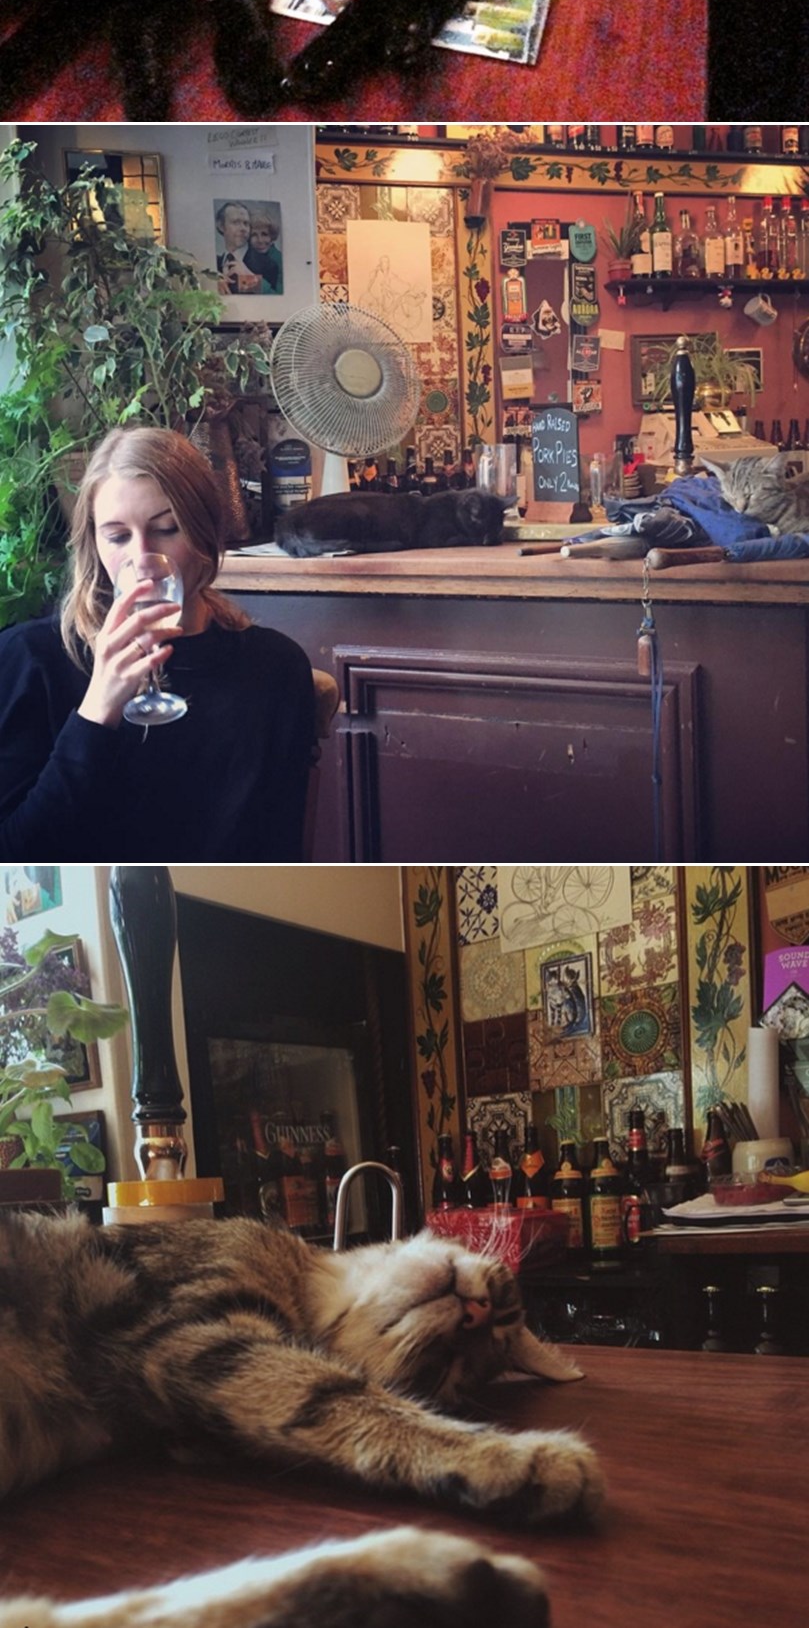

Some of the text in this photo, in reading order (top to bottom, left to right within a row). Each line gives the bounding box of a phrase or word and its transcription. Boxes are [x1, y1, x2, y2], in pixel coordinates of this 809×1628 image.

[533, 436, 555, 464] PORK
[781, 959, 808, 970] WAVE
[264, 1121, 331, 1145] GUINNESS
